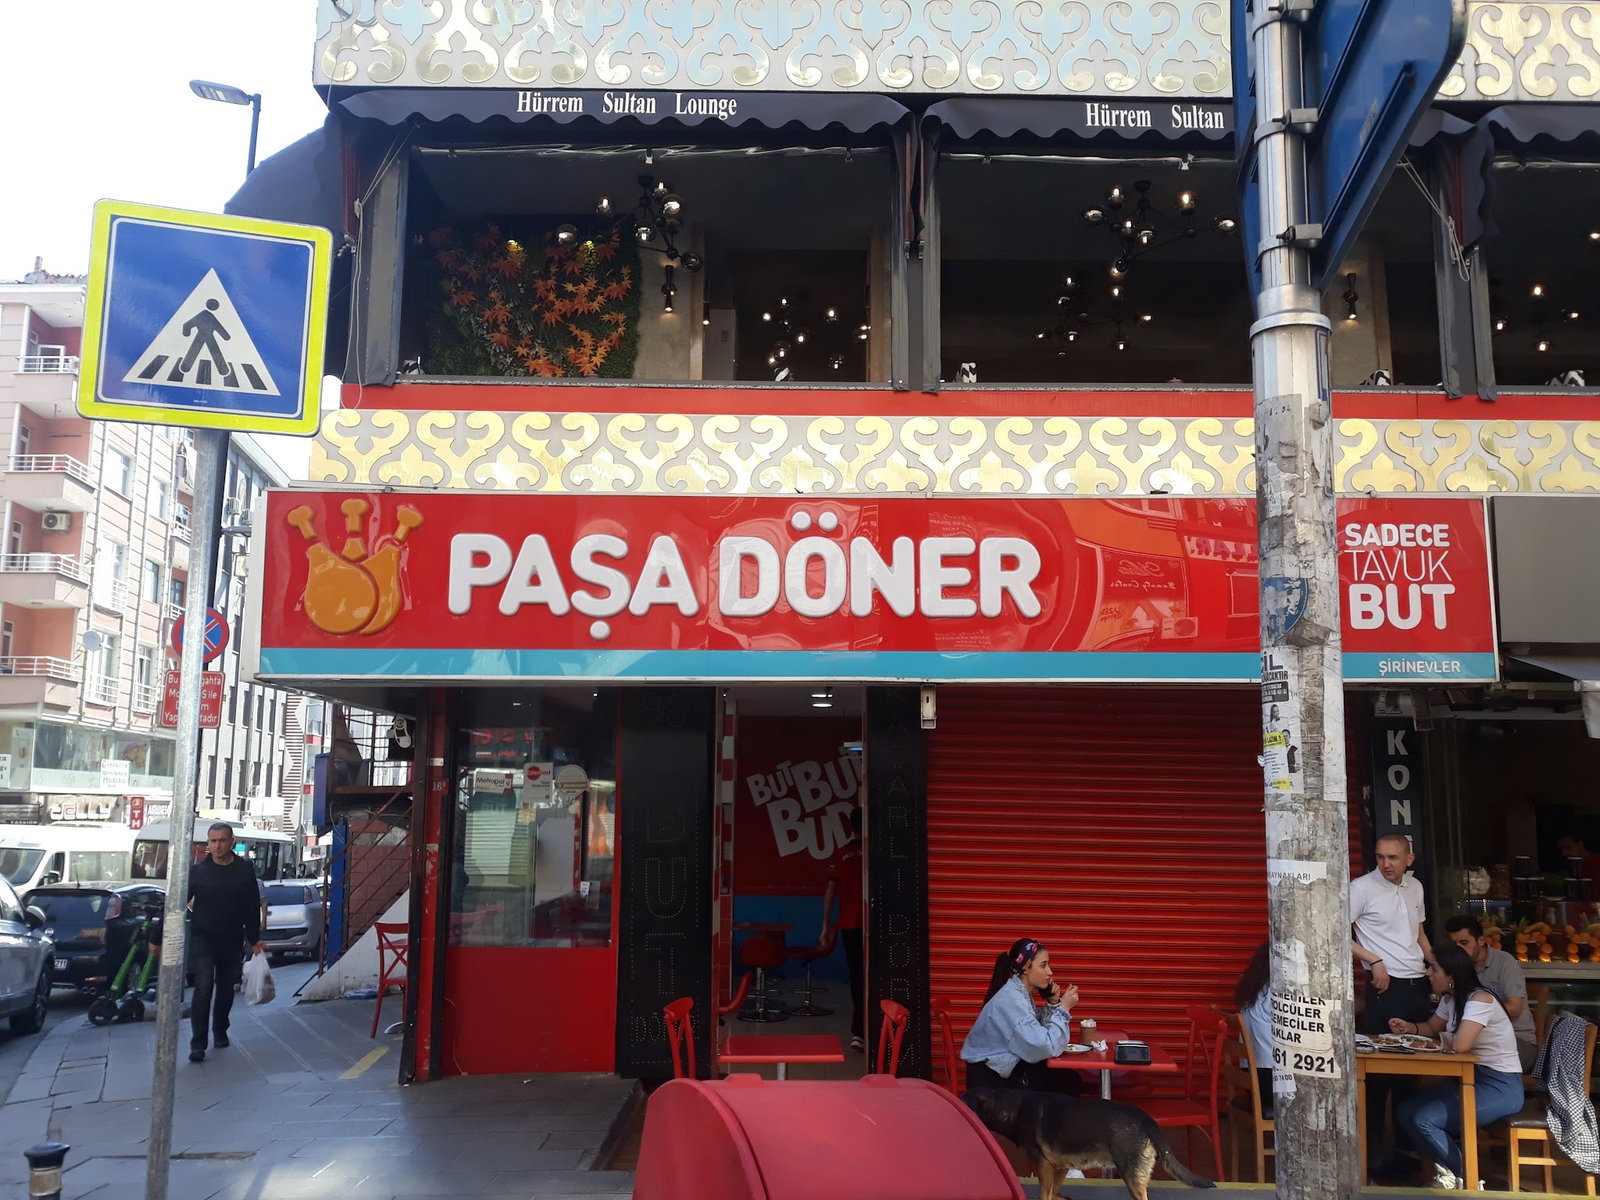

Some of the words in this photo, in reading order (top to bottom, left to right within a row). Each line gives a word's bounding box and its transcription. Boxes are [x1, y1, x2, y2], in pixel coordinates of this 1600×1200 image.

[516, 91, 583, 113] Hürrem
[603, 92, 656, 114] Sultan
[674, 93, 737, 120] Lounge
[1085, 102, 1152, 128] Hürrem
[1171, 104, 1225, 129] Sultan
[1344, 523, 1450, 547] SADECE
[448, 533, 700, 640] PAŞA
[719, 510, 1042, 618] DÖNER
[1344, 550, 1453, 581] TAVUK
[1349, 583, 1456, 630] BUT
[168, 673, 179, 684] Bu
[1379, 658, 1461, 676] ŞİRİNEVLER
[746, 761, 795, 807] BUT
[1386, 729, 1414, 877] KON
[1271, 1011, 1325, 1033] EMECİLER
[1293, 1053, 1334, 1073] 2921
